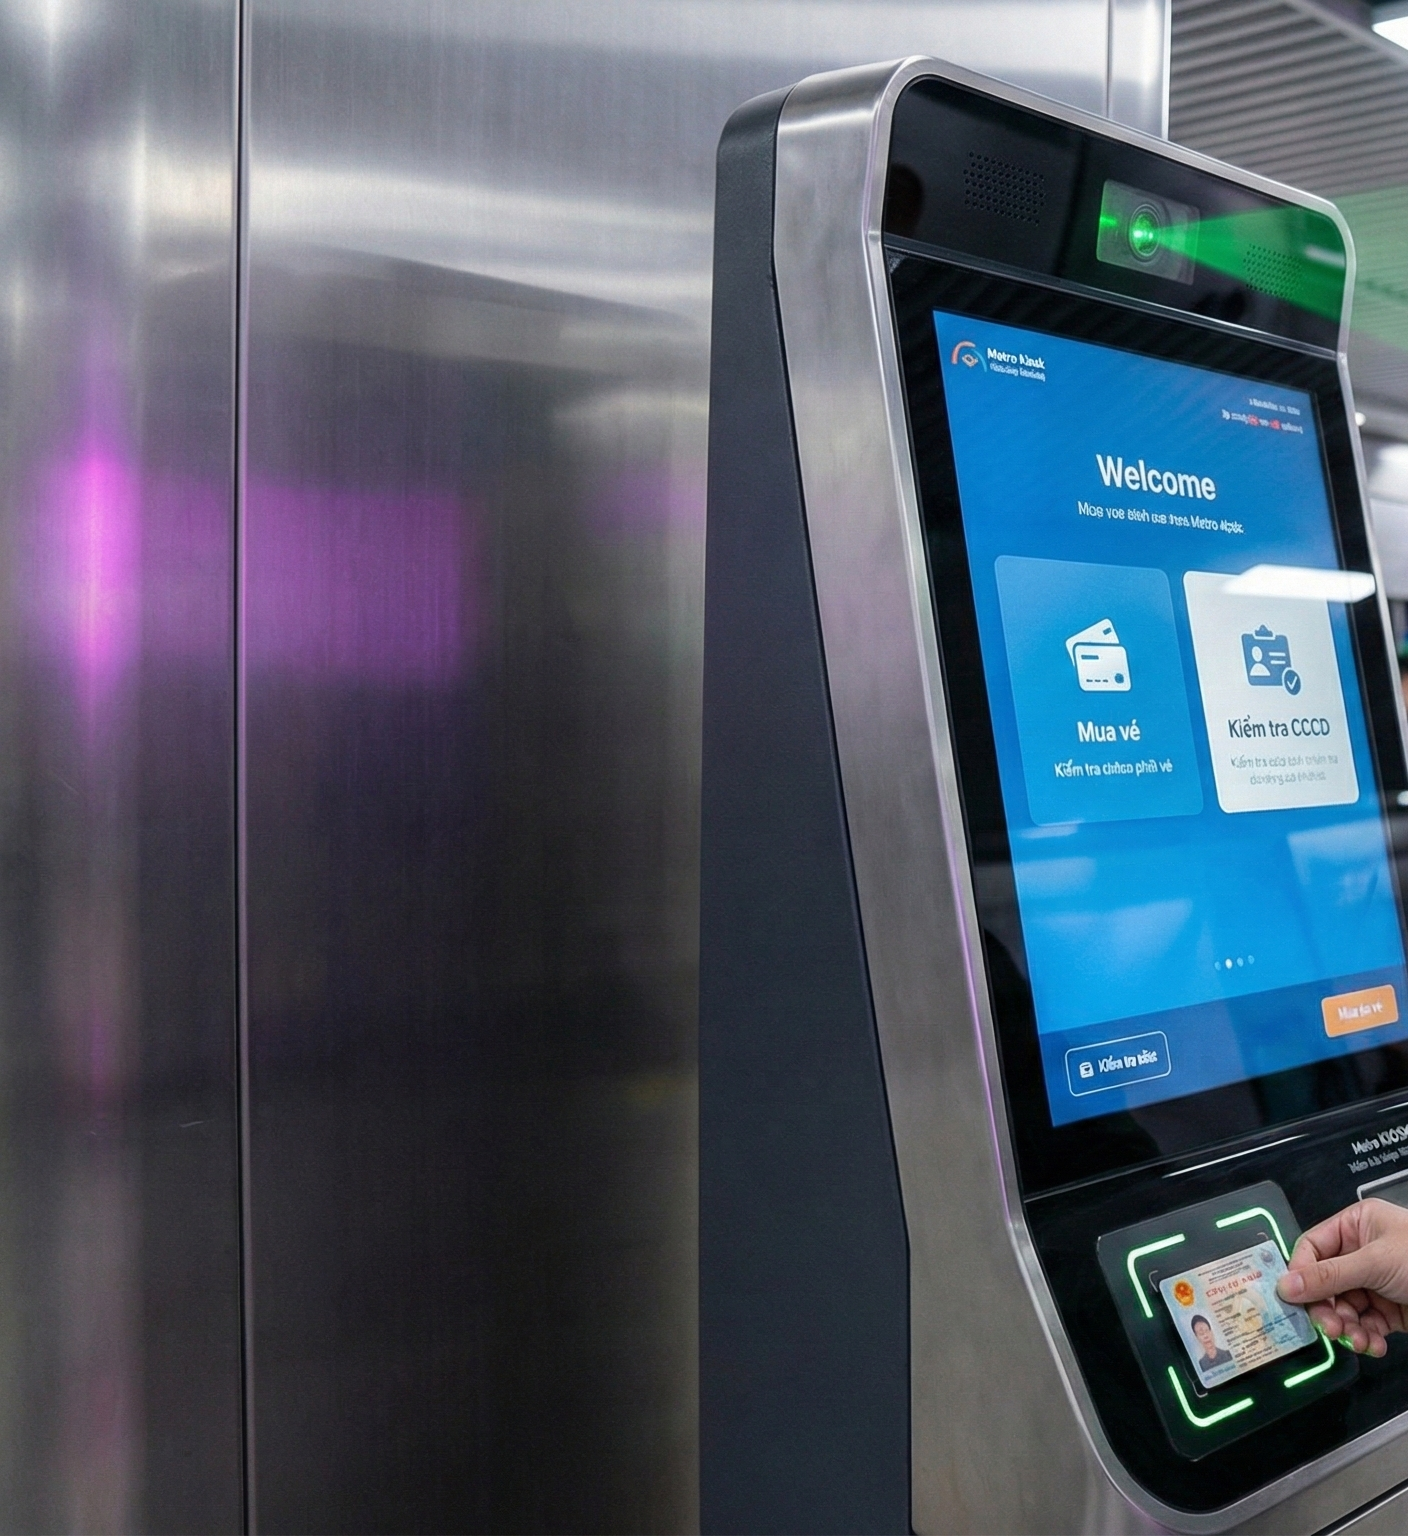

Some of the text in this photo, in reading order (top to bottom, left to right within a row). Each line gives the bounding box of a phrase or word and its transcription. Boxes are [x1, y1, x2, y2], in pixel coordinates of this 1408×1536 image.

[1096, 454, 1216, 500] Welcome
[1077, 719, 1141, 743] Mua vé
[1228, 714, 1330, 738] Kiểm tra CCCD
